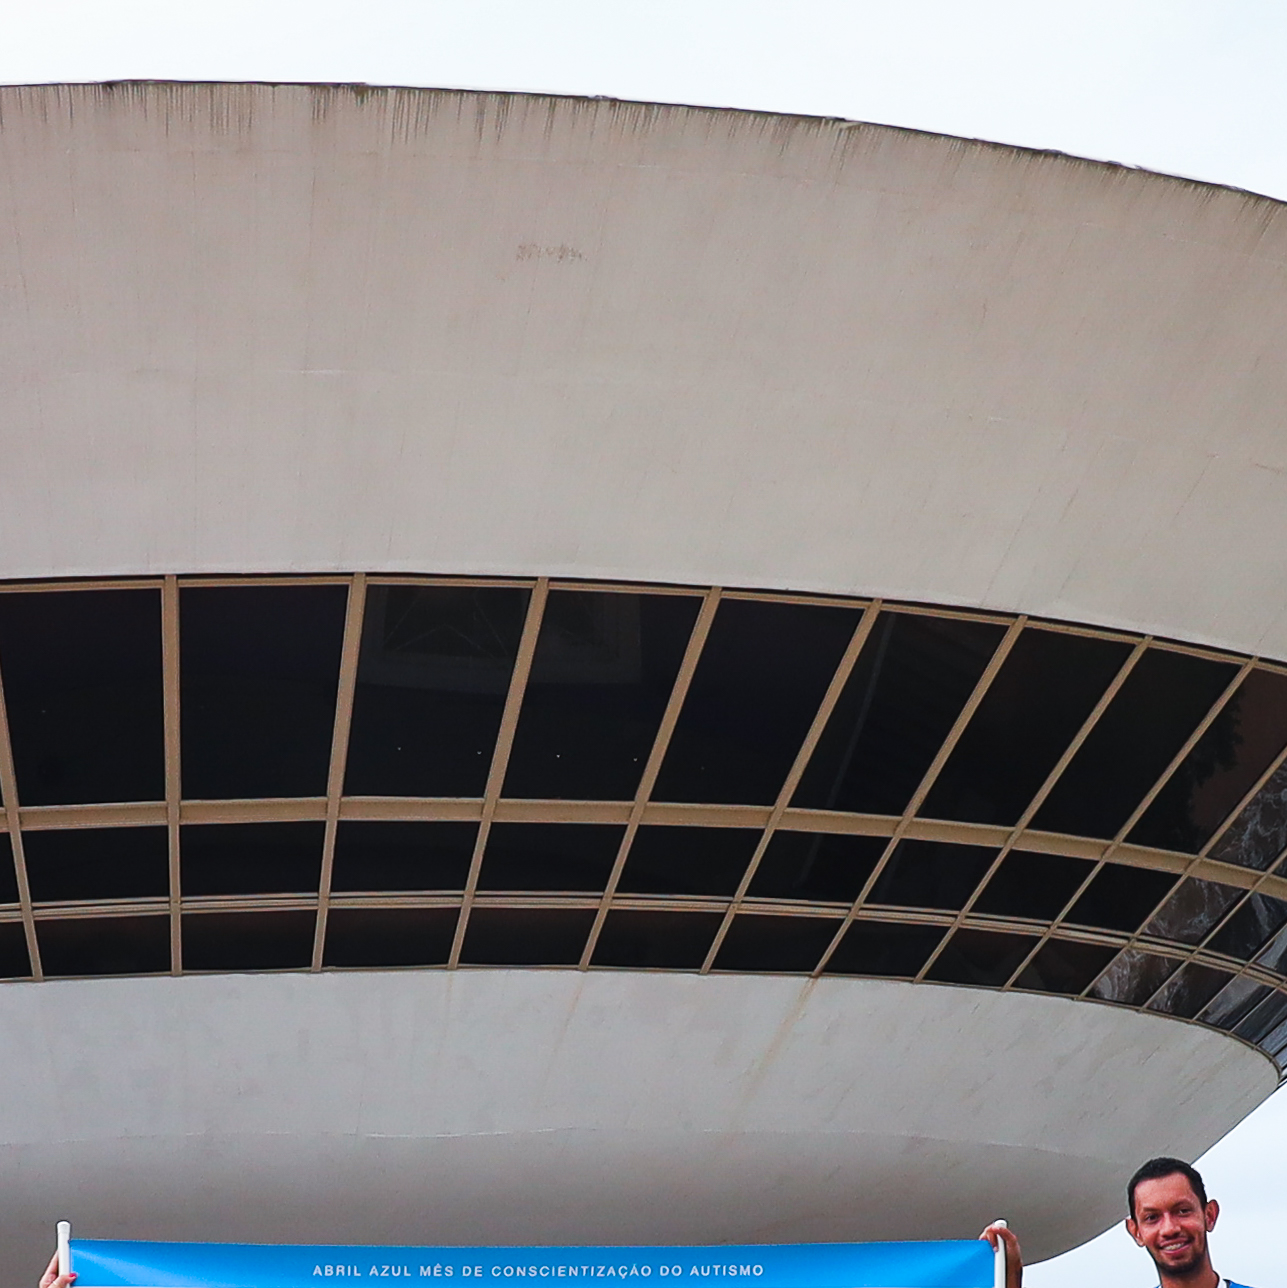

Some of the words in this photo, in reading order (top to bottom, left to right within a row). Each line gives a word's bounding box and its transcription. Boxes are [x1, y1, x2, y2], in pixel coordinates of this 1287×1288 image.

[312, 1264, 362, 1277] ABRIL
[368, 1264, 412, 1277] AZUL
[419, 1262, 454, 1277] MÊS
[462, 1264, 483, 1277] DE
[491, 1263, 652, 1279] CONSCIENTIZAÇÃO
[659, 1264, 683, 1277] DO
[689, 1264, 764, 1277] AUTISMO
